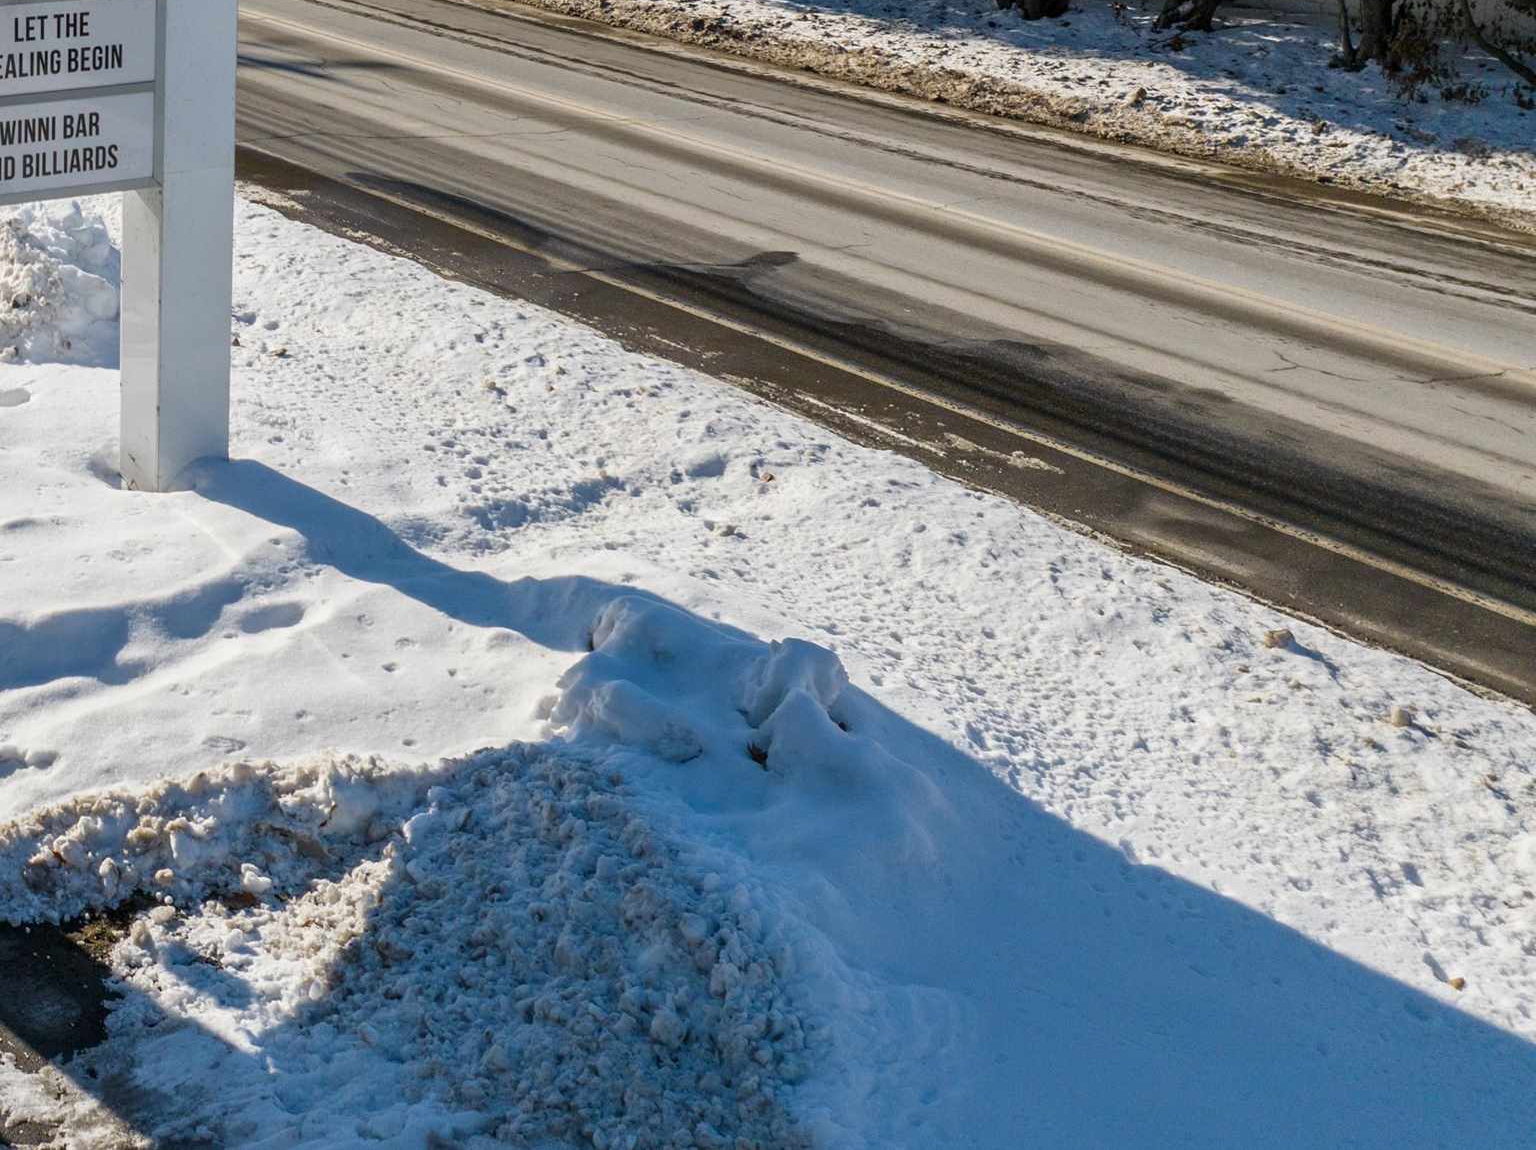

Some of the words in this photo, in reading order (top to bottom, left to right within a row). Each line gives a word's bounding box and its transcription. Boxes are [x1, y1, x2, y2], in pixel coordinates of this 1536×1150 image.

[14, 15, 46, 43] LET
[53, 11, 90, 38] THE
[67, 43, 124, 73] BEGIN
[0, 115, 57, 146] WINNI
[63, 112, 100, 139] BAR
[22, 144, 119, 178] BILLIARDS
